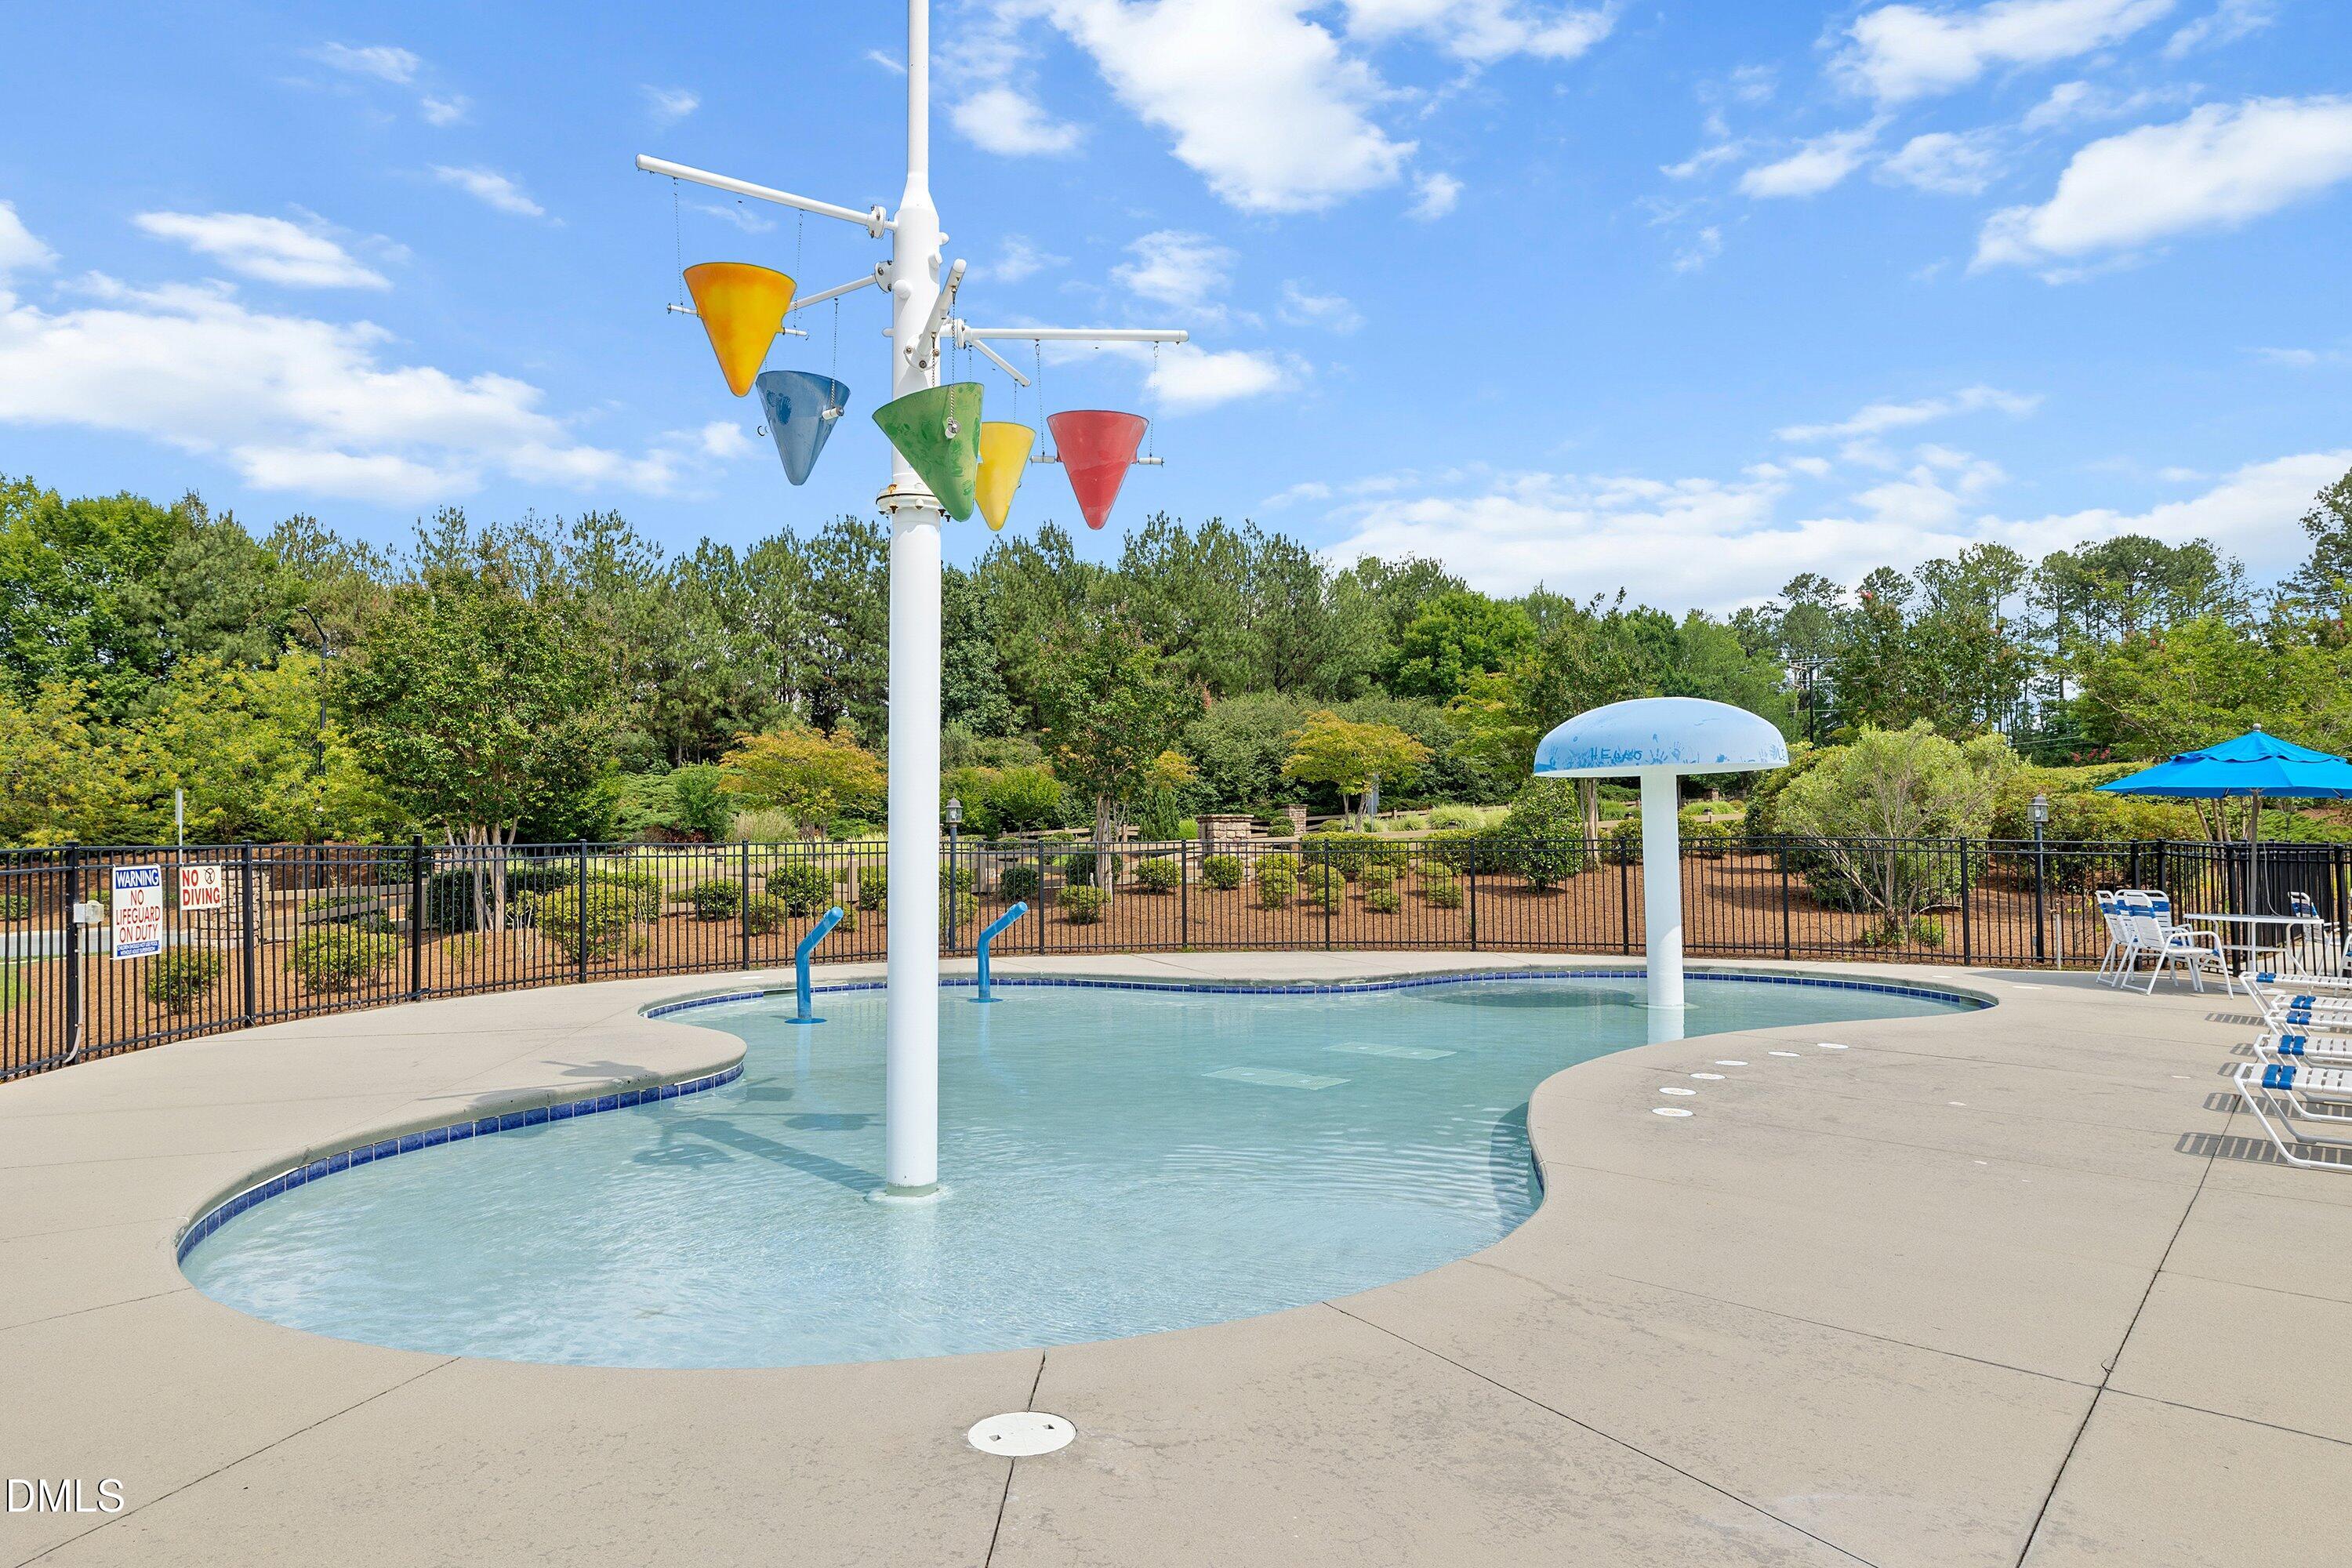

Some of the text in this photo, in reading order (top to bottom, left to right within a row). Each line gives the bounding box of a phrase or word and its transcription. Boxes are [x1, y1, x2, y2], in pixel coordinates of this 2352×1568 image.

[116, 869, 159, 887] WARNING
[182, 869, 198, 887] NO
[130, 889, 144, 906] NO
[183, 887, 220, 906] DIVING
[116, 906, 161, 925] LIFEGUARD
[119, 924, 158, 943] ON DUTY
